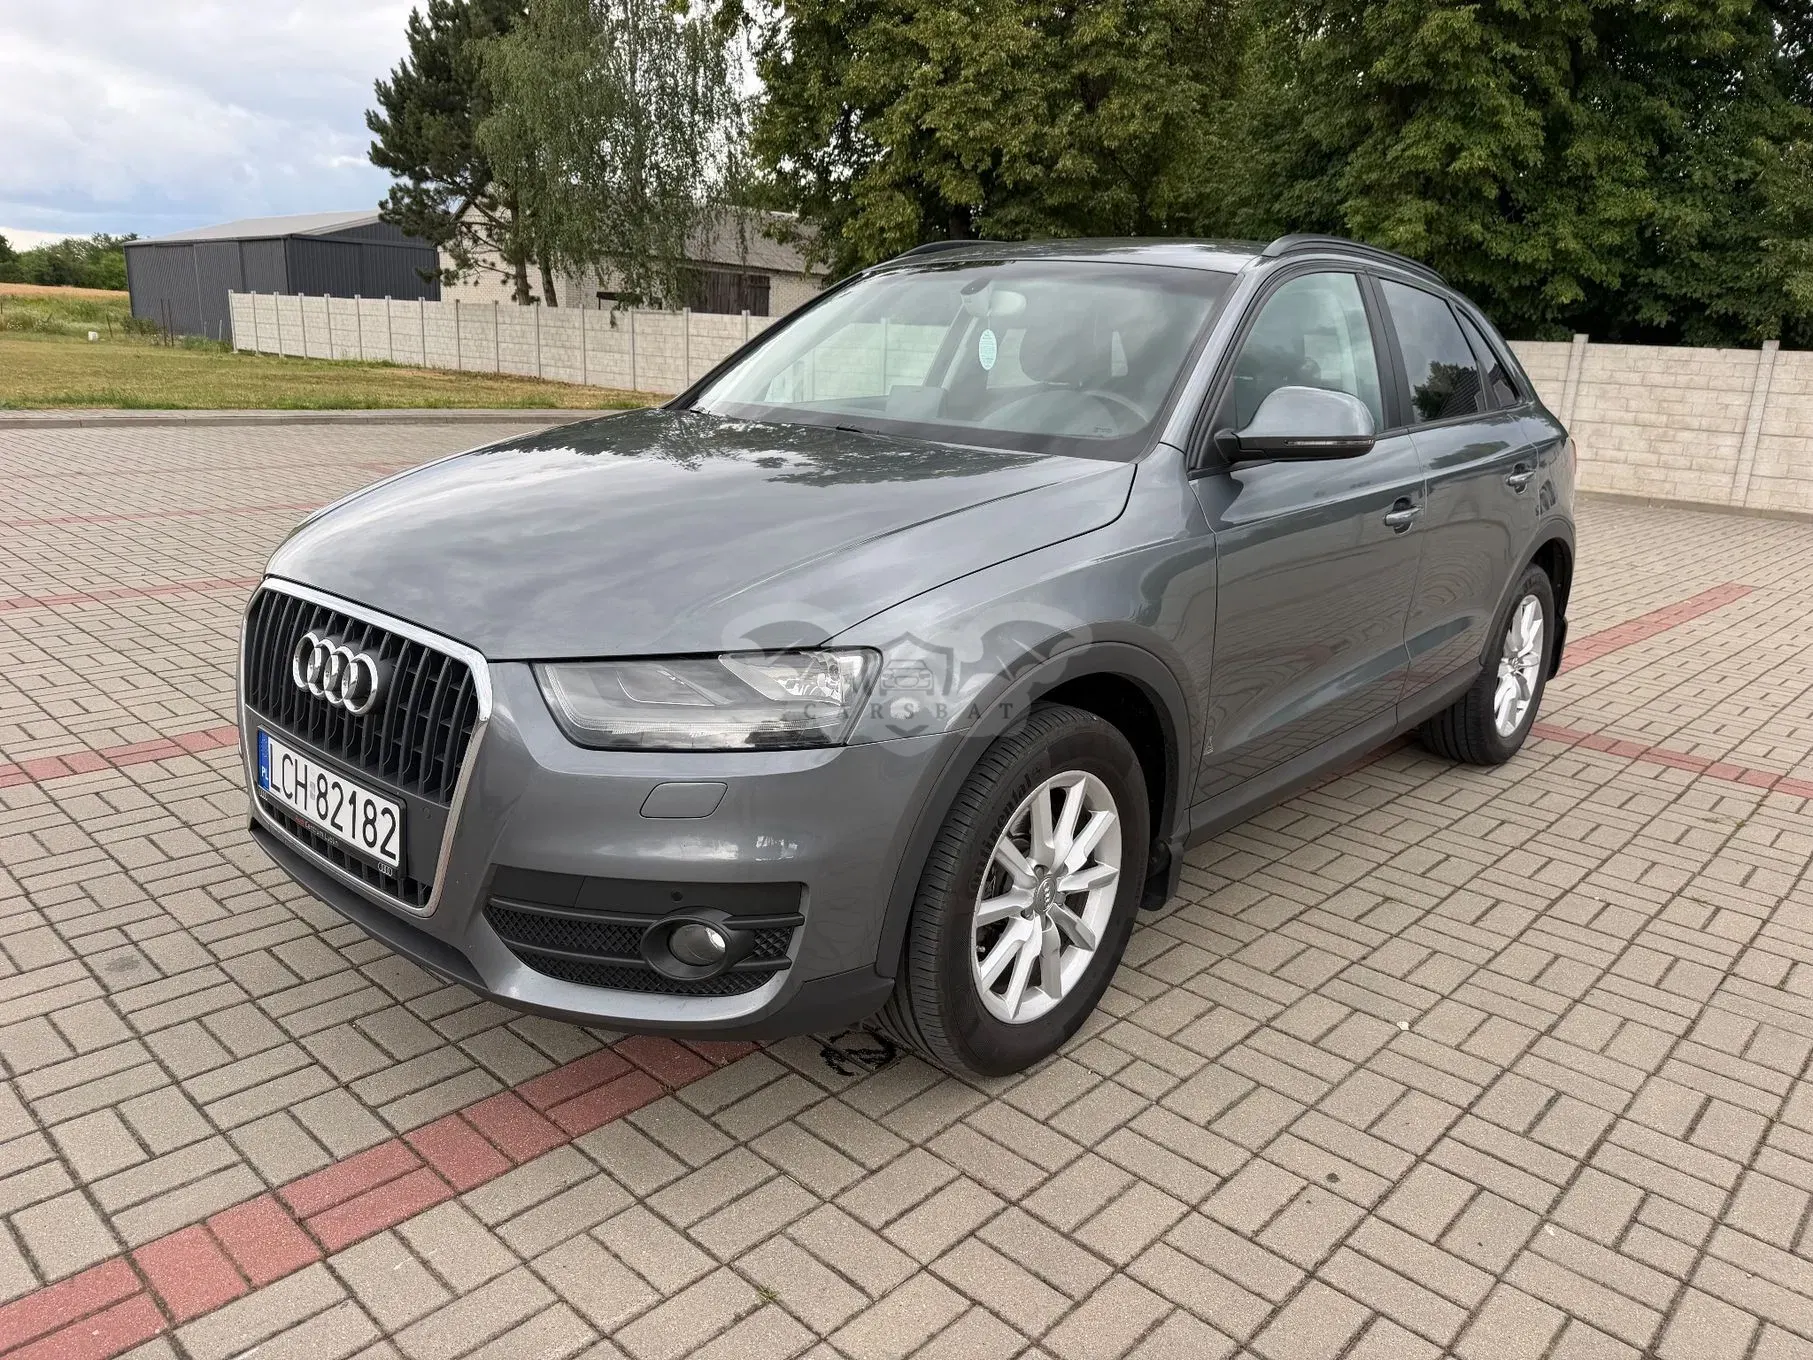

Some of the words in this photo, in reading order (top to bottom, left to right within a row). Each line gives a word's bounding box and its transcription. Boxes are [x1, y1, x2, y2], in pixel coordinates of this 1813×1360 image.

[261, 766, 269, 780] PL
[270, 743, 308, 811] LCH
[316, 773, 397, 861] 82182
